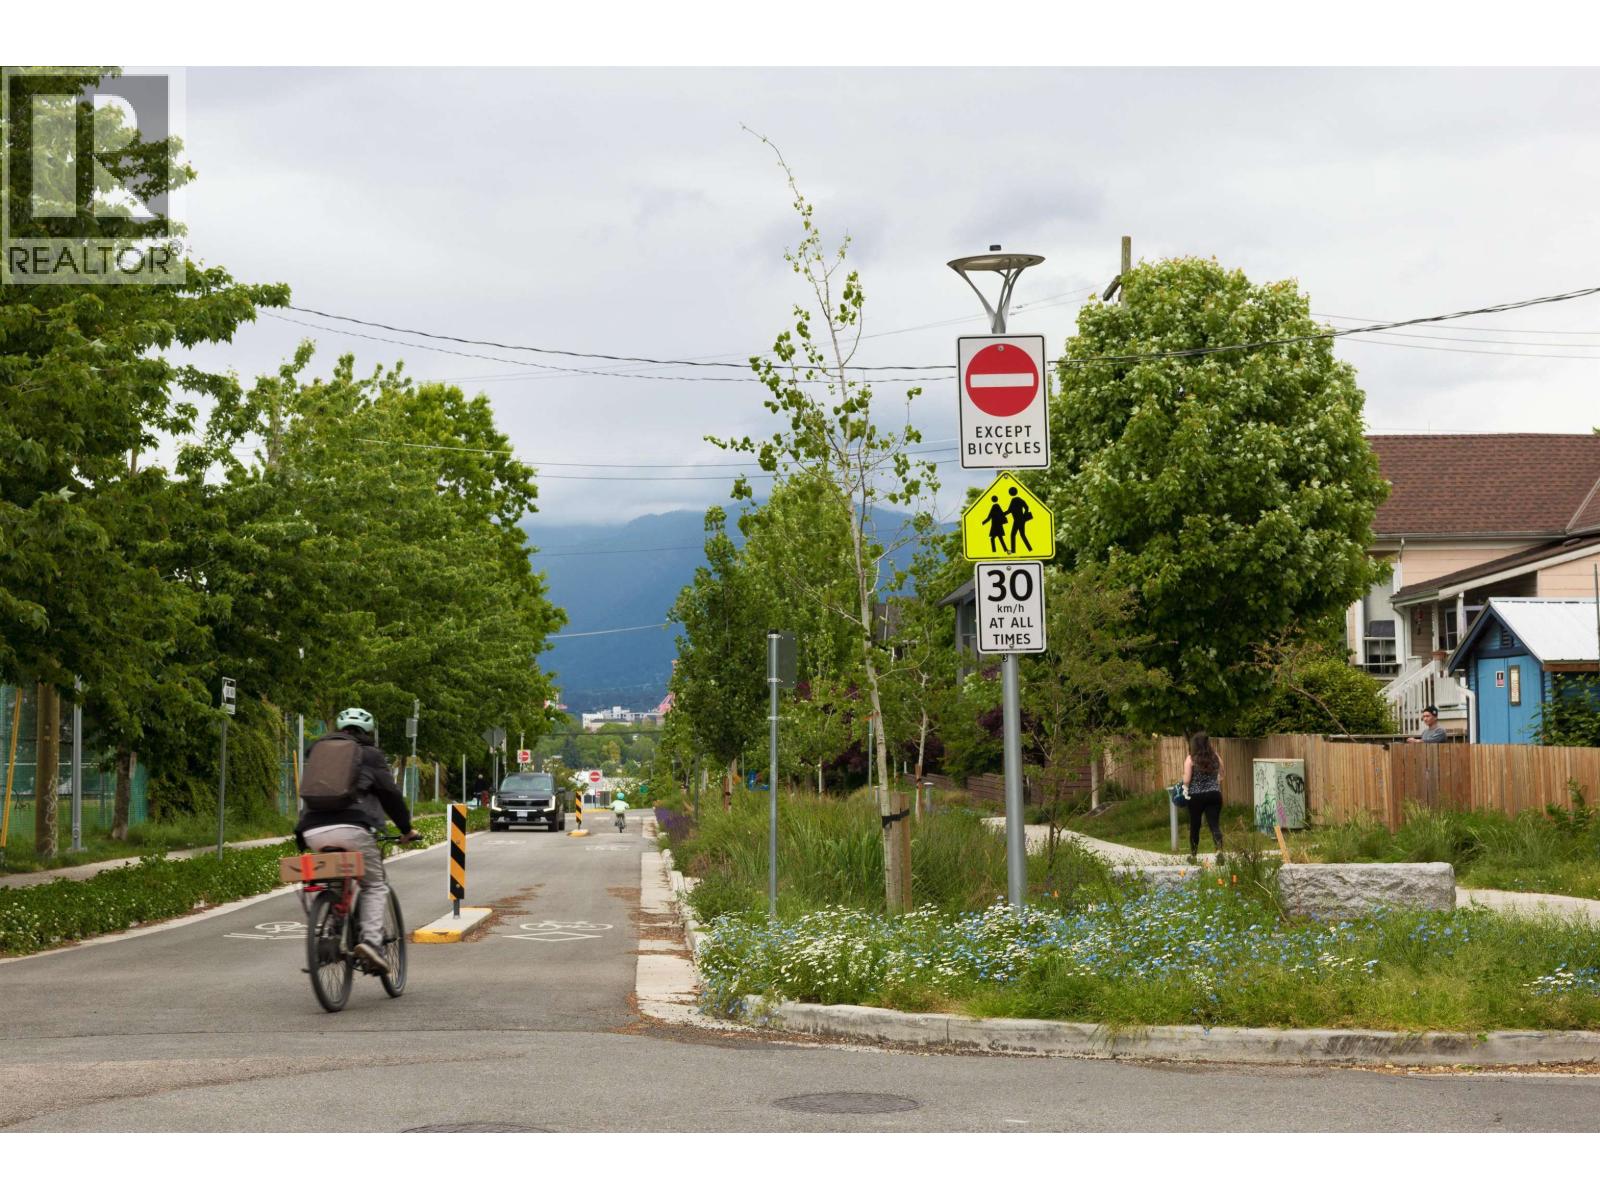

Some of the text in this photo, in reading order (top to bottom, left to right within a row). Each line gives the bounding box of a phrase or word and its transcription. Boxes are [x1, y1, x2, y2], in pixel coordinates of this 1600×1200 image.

[975, 425, 1032, 439] EXCEPT
[968, 441, 1041, 455] BICYCLES
[987, 569, 1034, 602] 30
[997, 603, 1025, 614] km/h
[989, 616, 1034, 629] AT ALL
[993, 633, 1031, 646] TIMES
